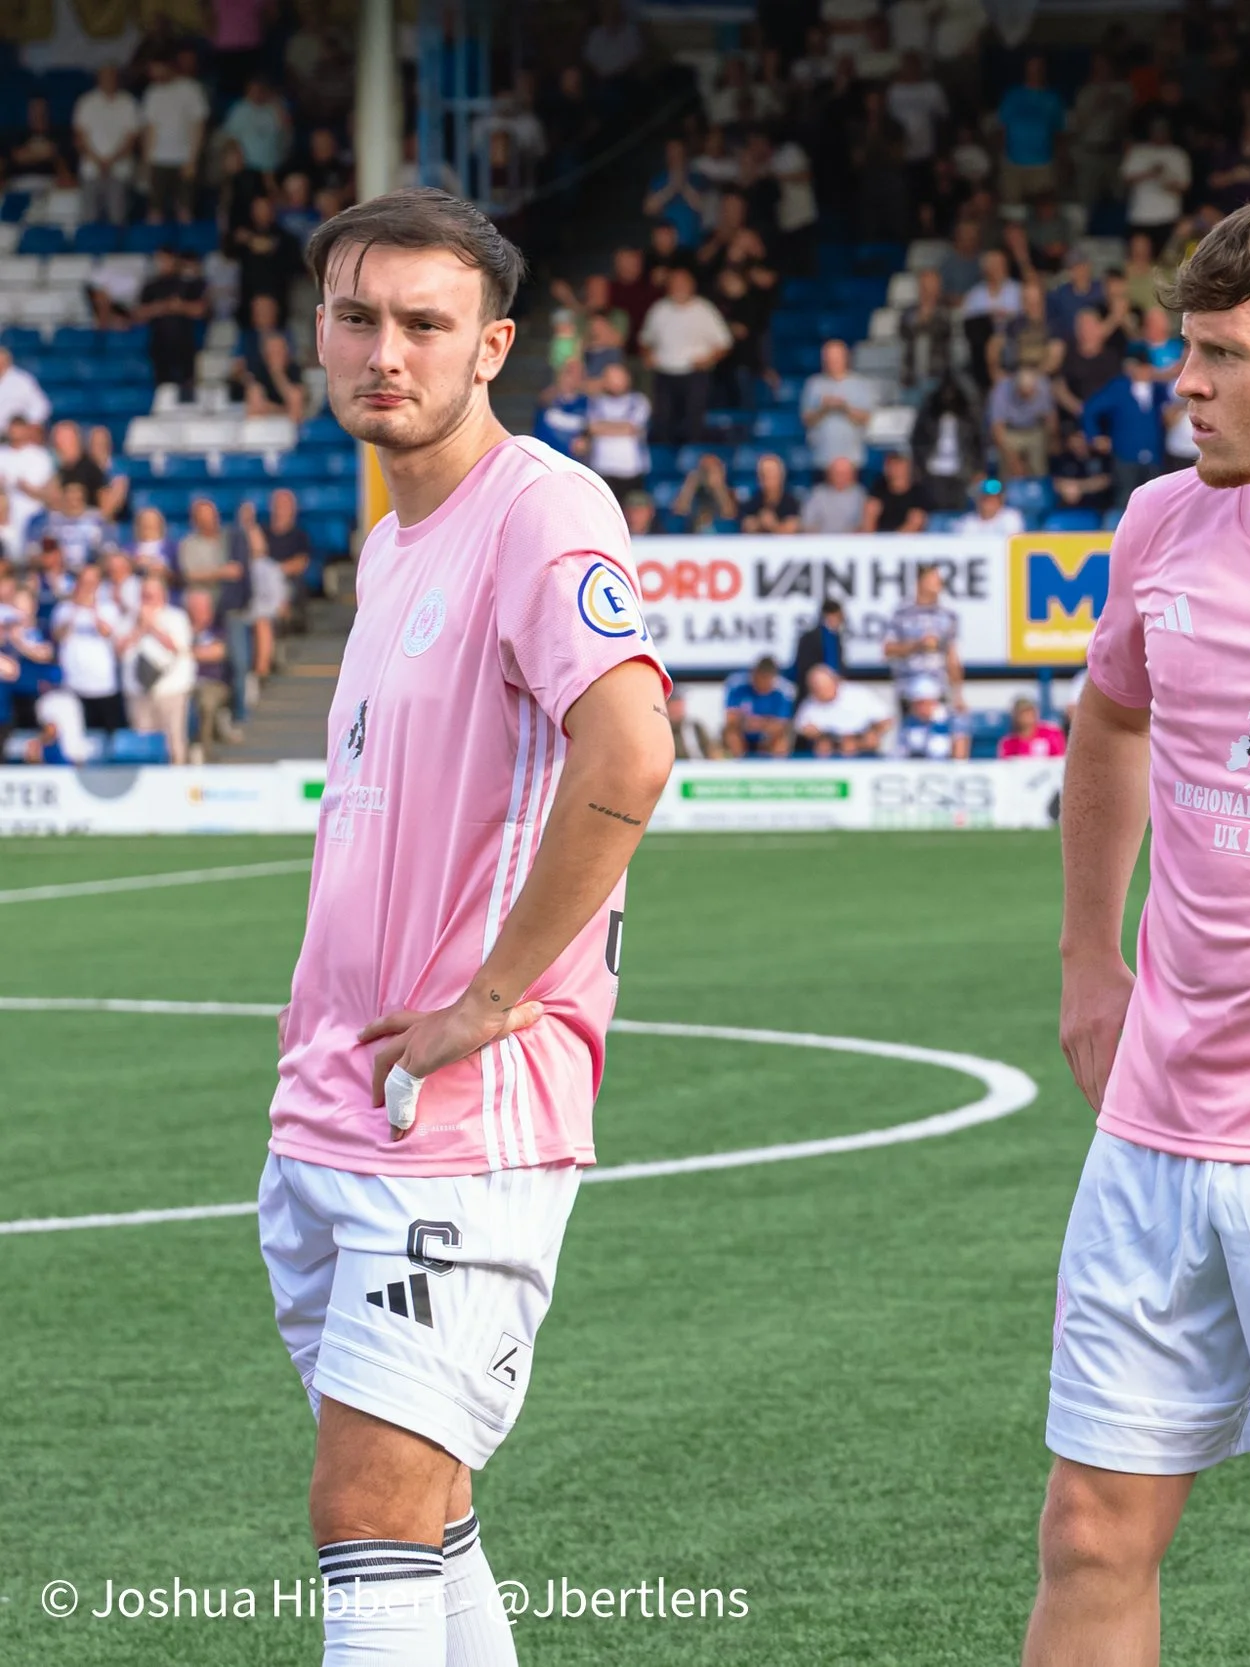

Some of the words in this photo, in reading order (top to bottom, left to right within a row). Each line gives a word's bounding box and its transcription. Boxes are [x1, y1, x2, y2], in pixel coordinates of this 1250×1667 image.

[755, 557, 857, 599] VAN
[684, 610, 776, 643] LANE
[1213, 824, 1242, 850] UK
